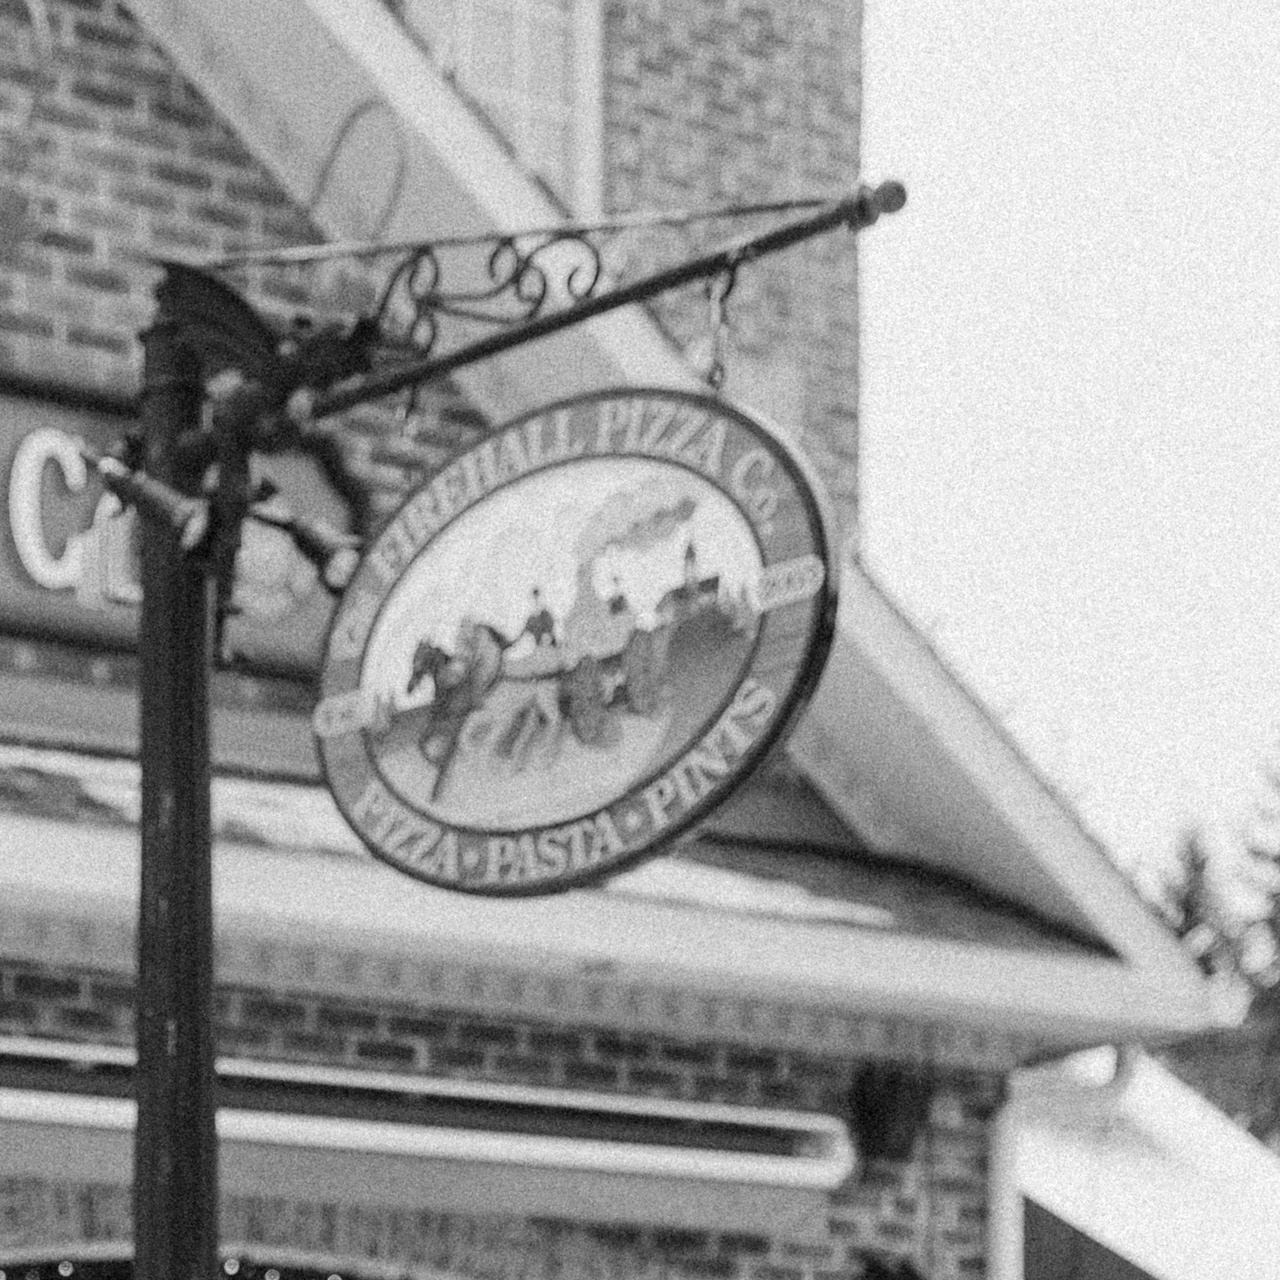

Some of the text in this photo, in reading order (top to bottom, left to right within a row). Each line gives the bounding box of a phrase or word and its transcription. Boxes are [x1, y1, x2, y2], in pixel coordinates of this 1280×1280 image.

[369, 410, 589, 580] FIREHALL
[596, 400, 728, 476] PIZZA
[352, 678, 777, 881] PIZZA PASTA PINTS
